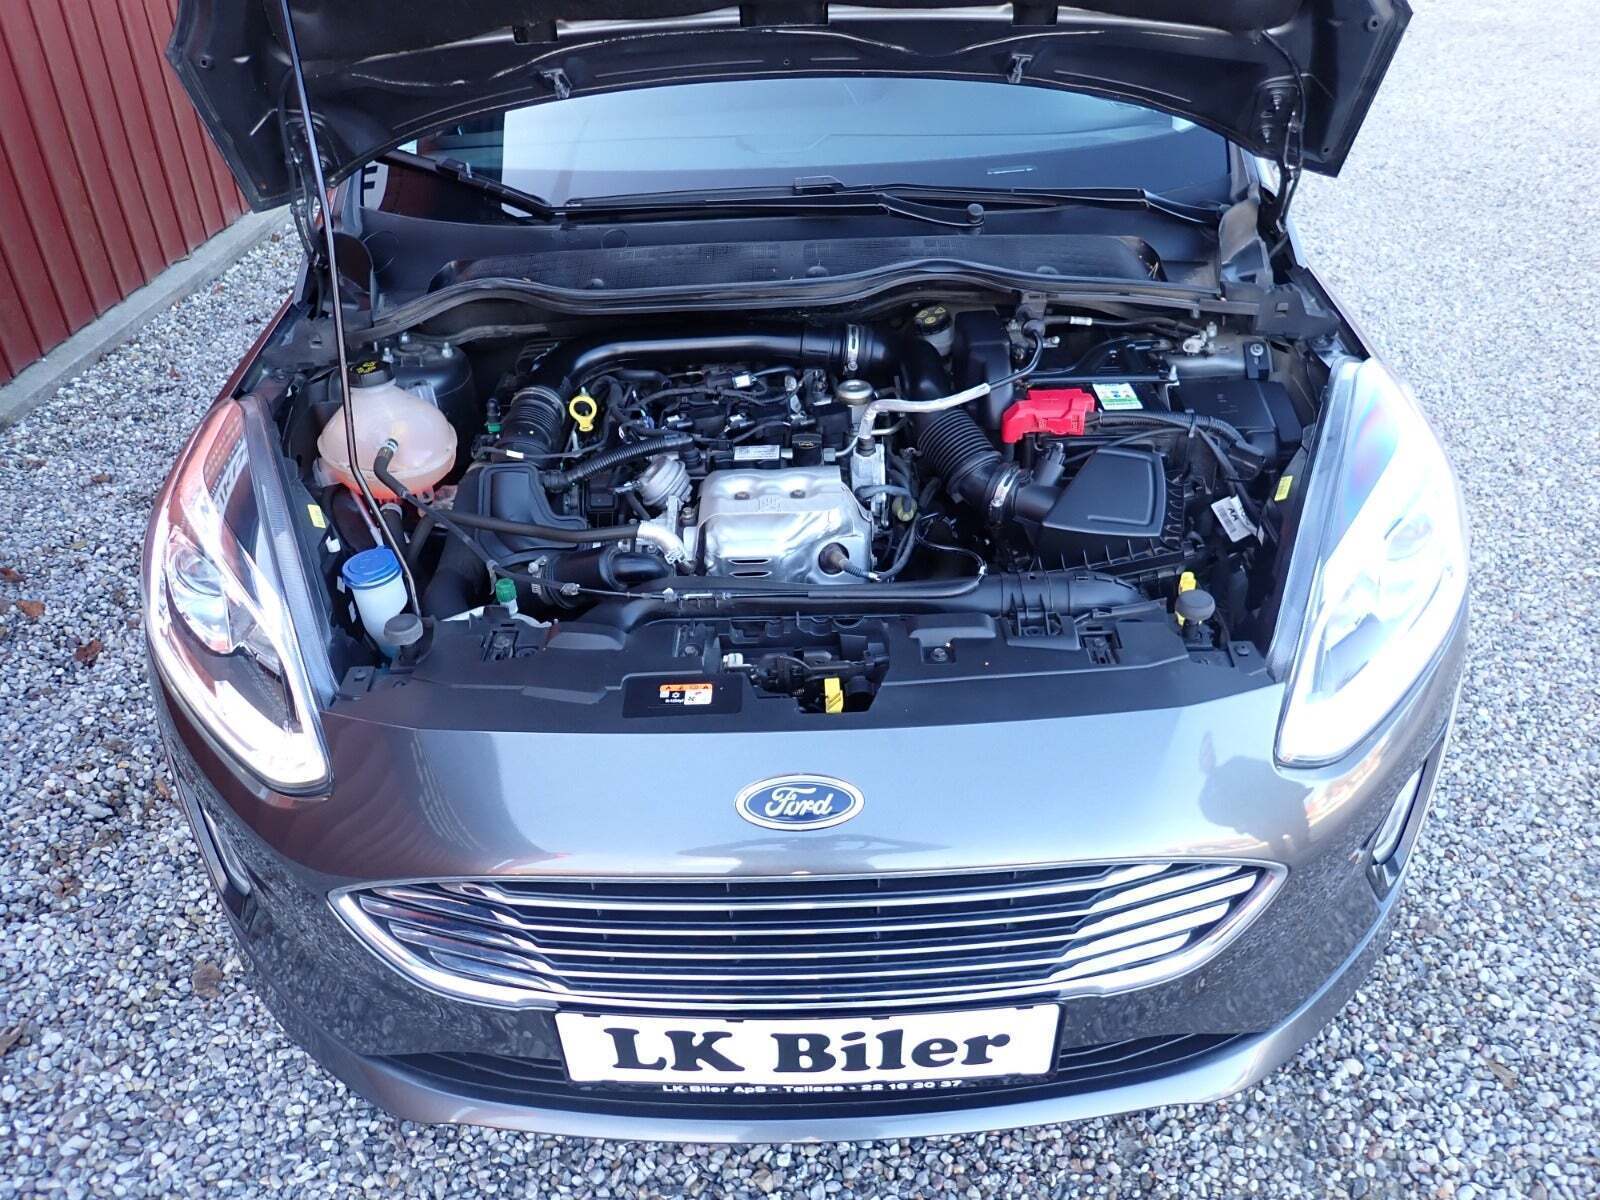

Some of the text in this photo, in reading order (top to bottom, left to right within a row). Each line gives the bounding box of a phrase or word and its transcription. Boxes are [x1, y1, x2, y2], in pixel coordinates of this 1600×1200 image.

[765, 786, 834, 816] Ford
[603, 1027, 1011, 1073] LK Biler
[662, 1084, 684, 1092] LK
[689, 1085, 728, 1093] Biler
